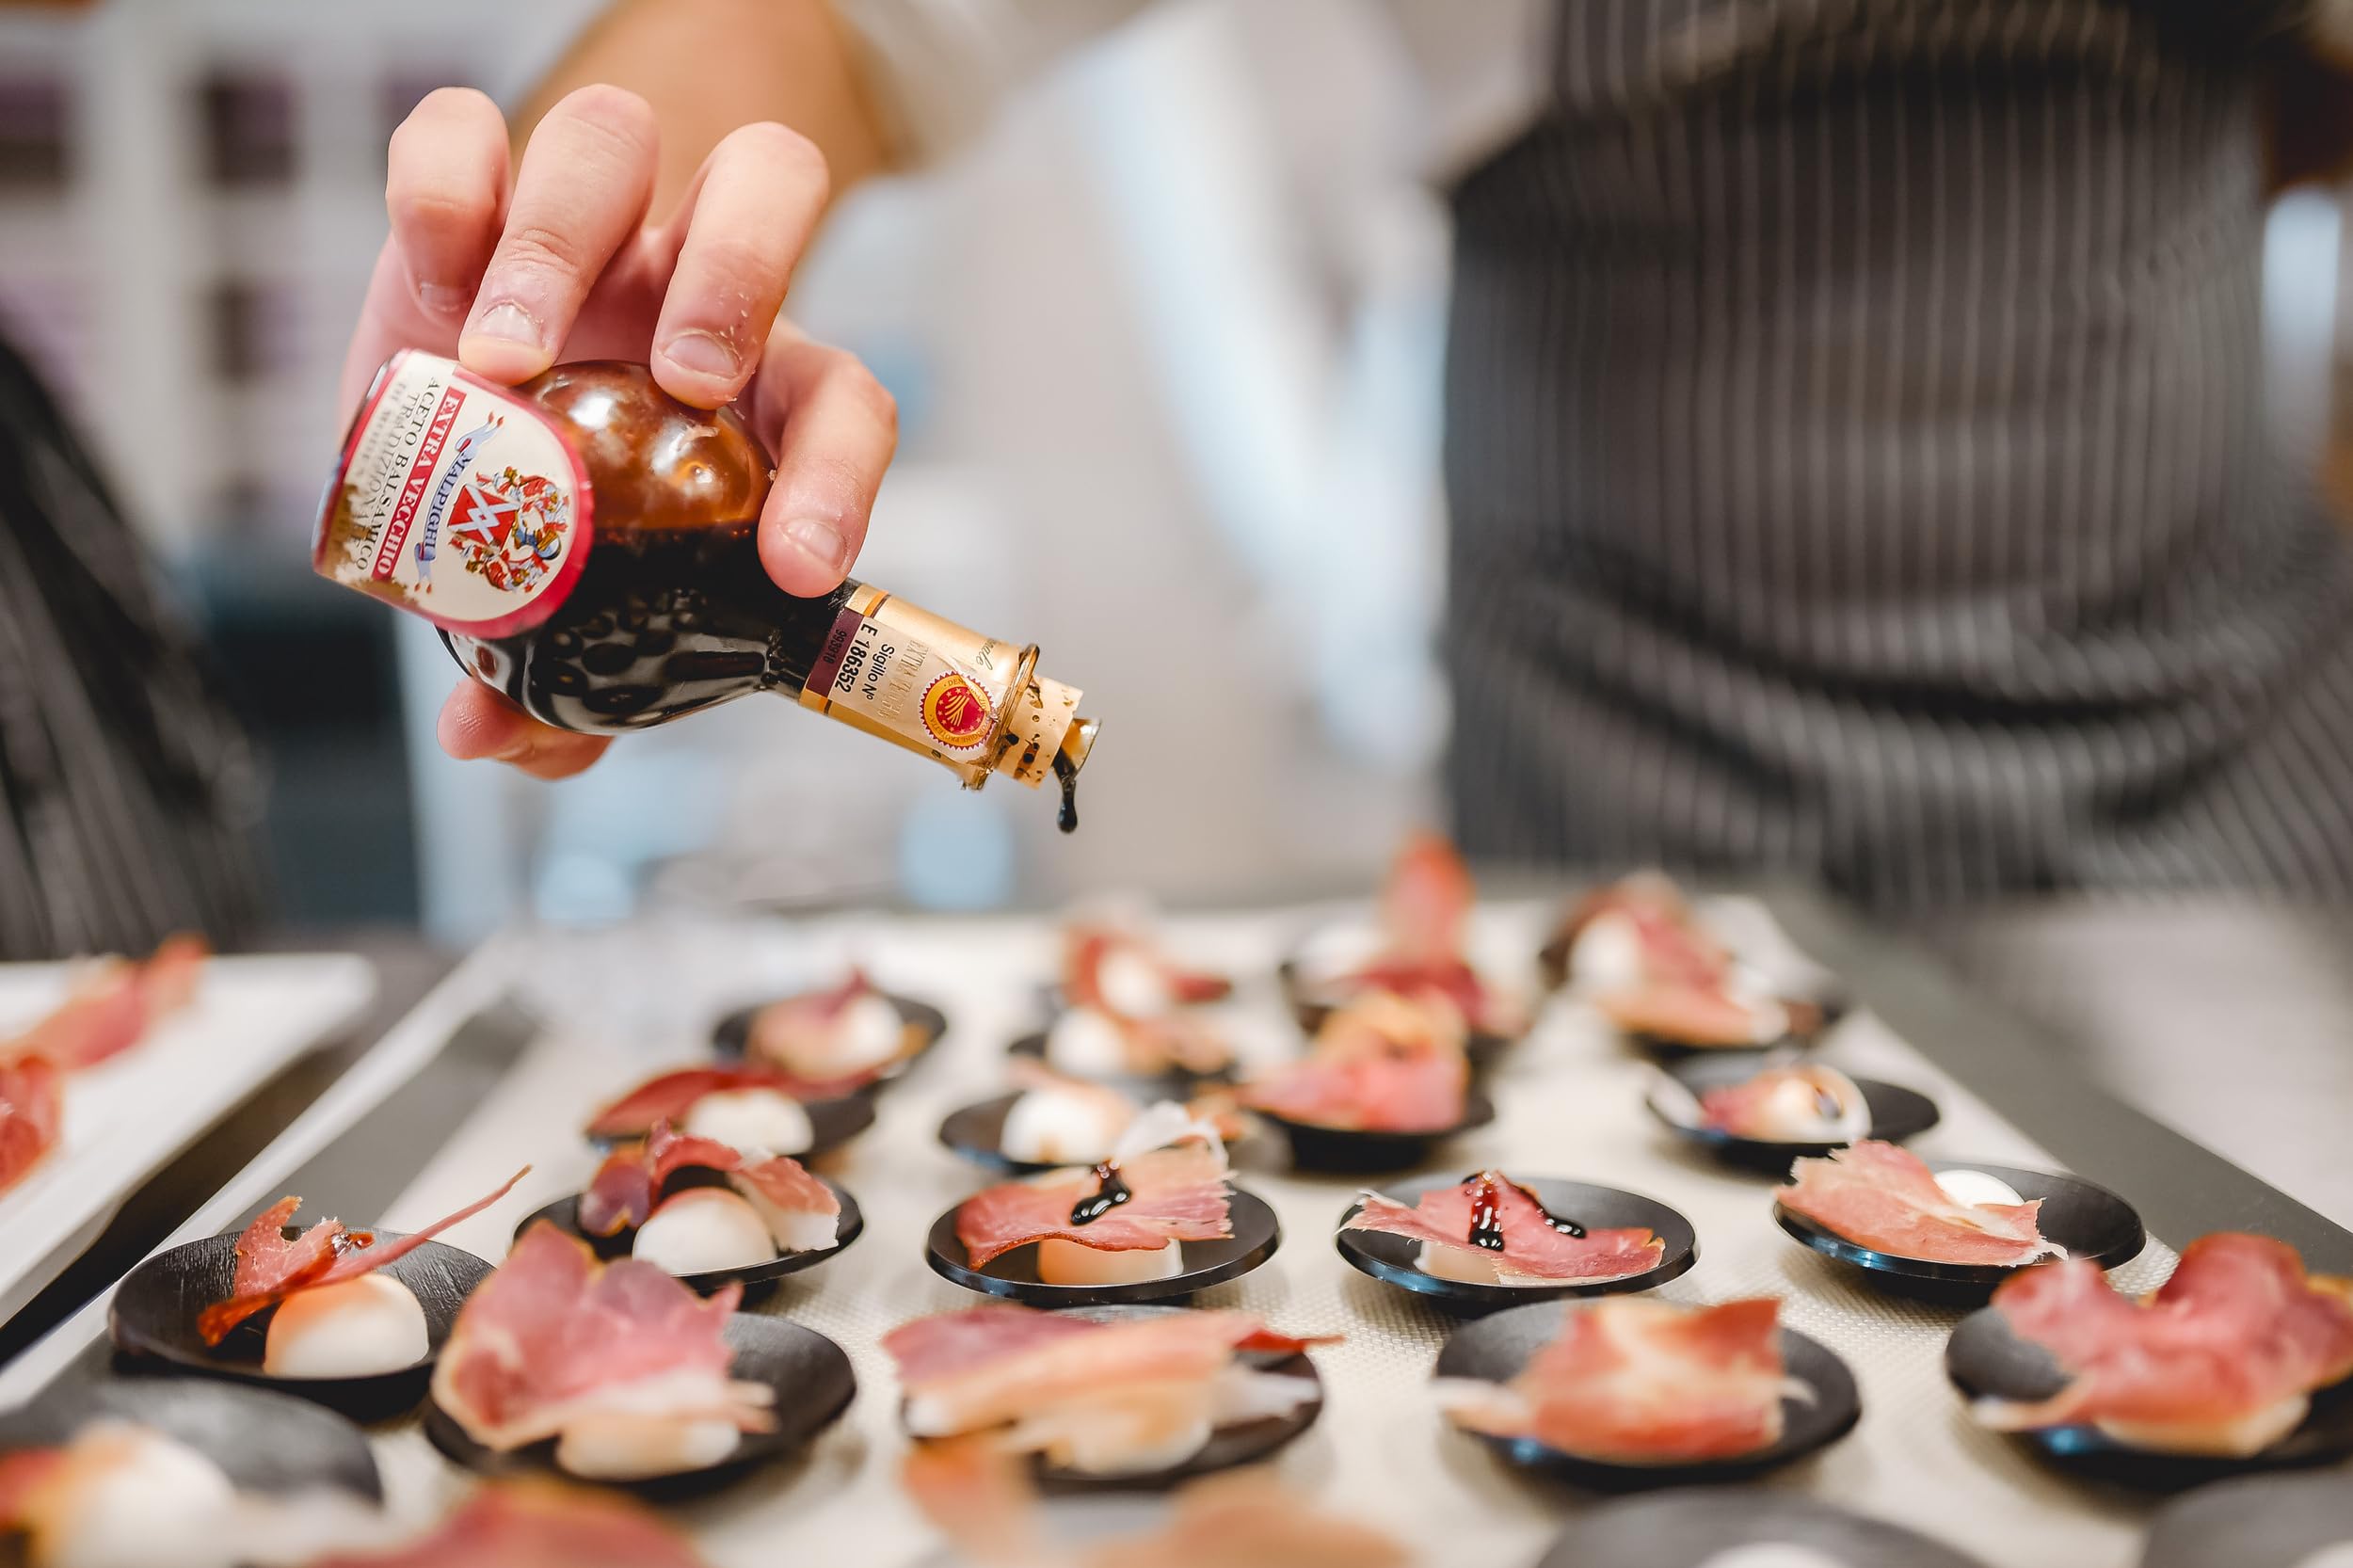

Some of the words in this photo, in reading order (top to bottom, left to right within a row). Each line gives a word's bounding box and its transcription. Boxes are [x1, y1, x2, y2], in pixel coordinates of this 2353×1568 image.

[403, 376, 441, 446] ACETO
[415, 392, 460, 470] EXTRA
[354, 453, 409, 571] BALSAMICO
[374, 477, 425, 576] VECCHIO
[424, 455, 472, 550] MALPIGHI
[833, 635, 872, 694] 186352
[859, 622, 878, 637] E
[866, 642, 895, 684] Sigillo
